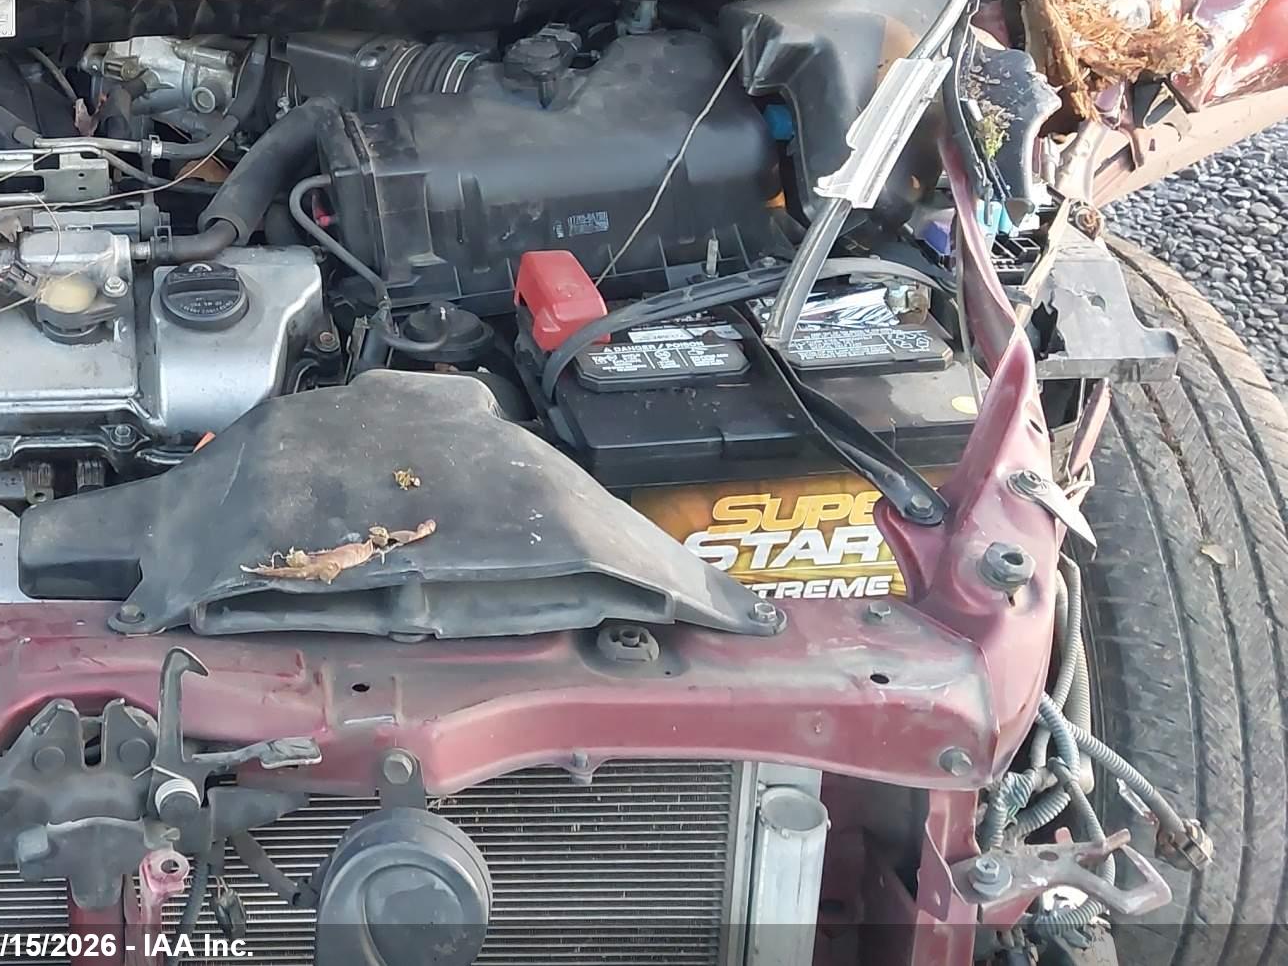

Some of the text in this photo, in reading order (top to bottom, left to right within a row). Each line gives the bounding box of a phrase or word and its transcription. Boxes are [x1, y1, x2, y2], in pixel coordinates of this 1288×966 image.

[614, 344, 656, 353] DANGER
[665, 340, 705, 349] POISON
[708, 492, 882, 534] SUPE
[683, 526, 885, 571] STAR
